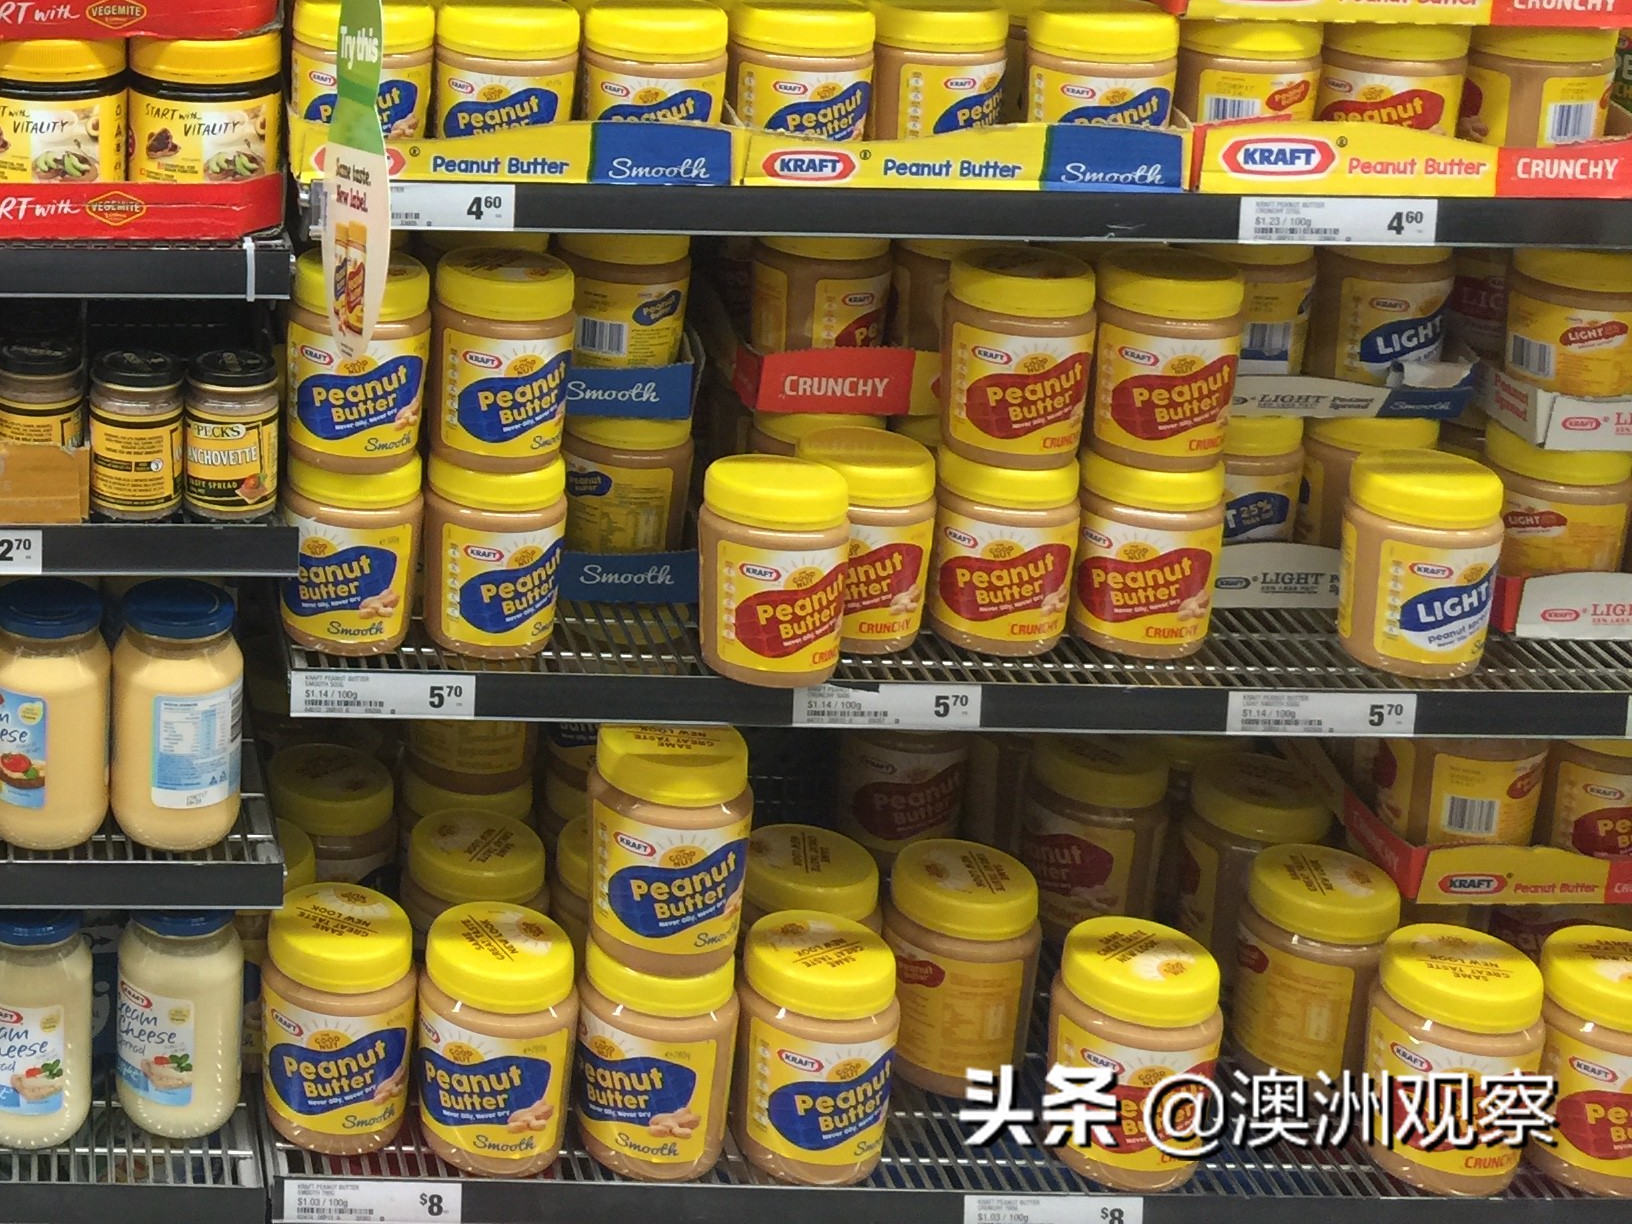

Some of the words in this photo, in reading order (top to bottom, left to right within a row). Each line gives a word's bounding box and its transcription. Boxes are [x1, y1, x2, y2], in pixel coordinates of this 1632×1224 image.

[33, 3, 80, 24] with
[91, 4, 142, 19] VEGEMITE
[182, 119, 243, 138] VITALITY
[431, 154, 503, 175] Peanut
[508, 156, 569, 177] Butter
[607, 157, 710, 180] Smooth
[779, 155, 841, 176] KRAFT
[467, 353, 498, 367] KRAFT
[312, 366, 408, 407] Peanut
[783, 377, 889, 398] CRUNCHY
[331, 391, 397, 424] Butter
[195, 424, 243, 438] PECK'S
[364, 435, 413, 453] Smooth
[207, 479, 239, 490] SPREAD
[955, 550, 1055, 589] Peanut
[1415, 564, 1449, 578] KRAFT
[976, 577, 1044, 605] Butter
[1416, 584, 1491, 626] LIGHT
[1145, 626, 1199, 639] CRUNCHY
[337, 689, 358, 701] 100g
[283, 1039, 387, 1082] Peanut
[472, 1134, 536, 1154] Smooth
